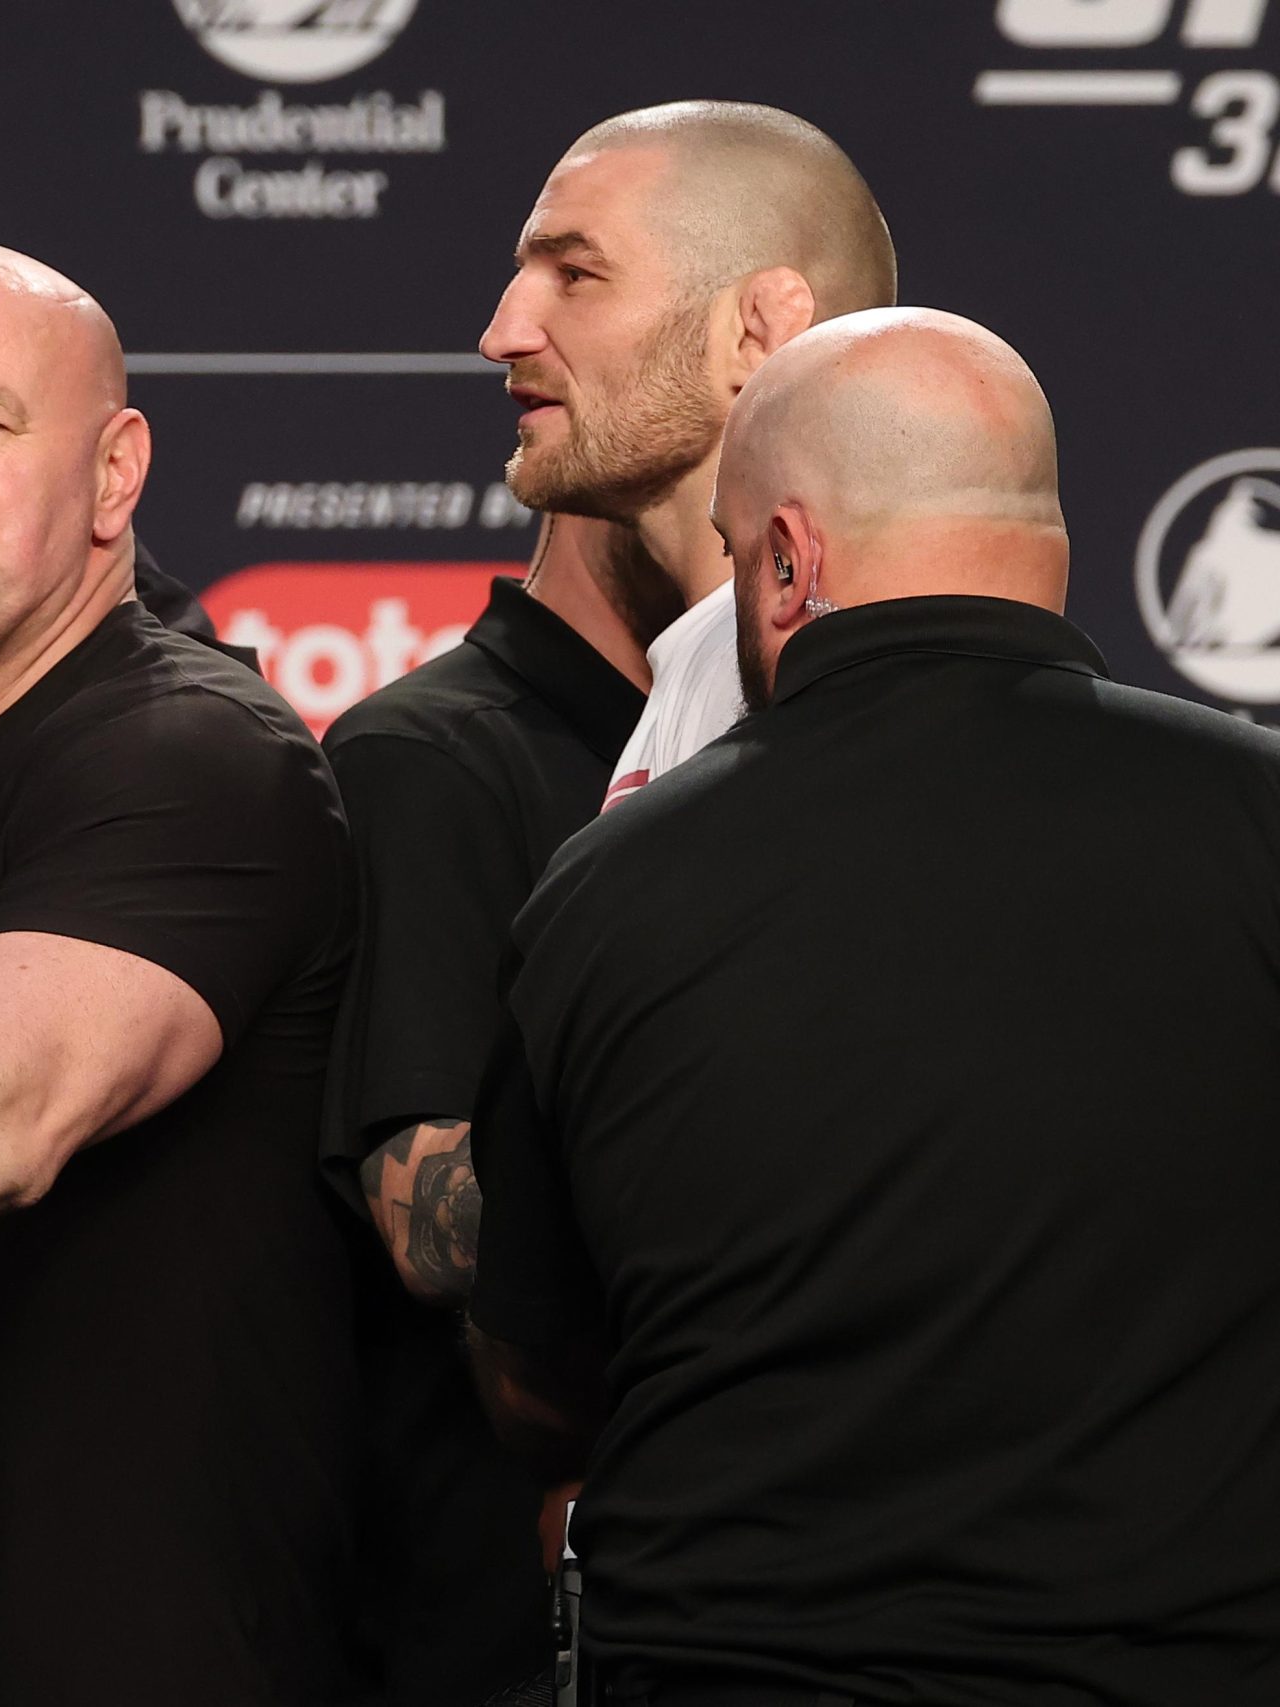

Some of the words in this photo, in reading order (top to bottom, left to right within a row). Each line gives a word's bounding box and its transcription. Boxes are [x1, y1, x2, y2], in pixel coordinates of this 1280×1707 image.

[139, 89, 446, 152] Prudential
[194, 155, 389, 218] Center
[235, 481, 475, 529] PRESENTED
